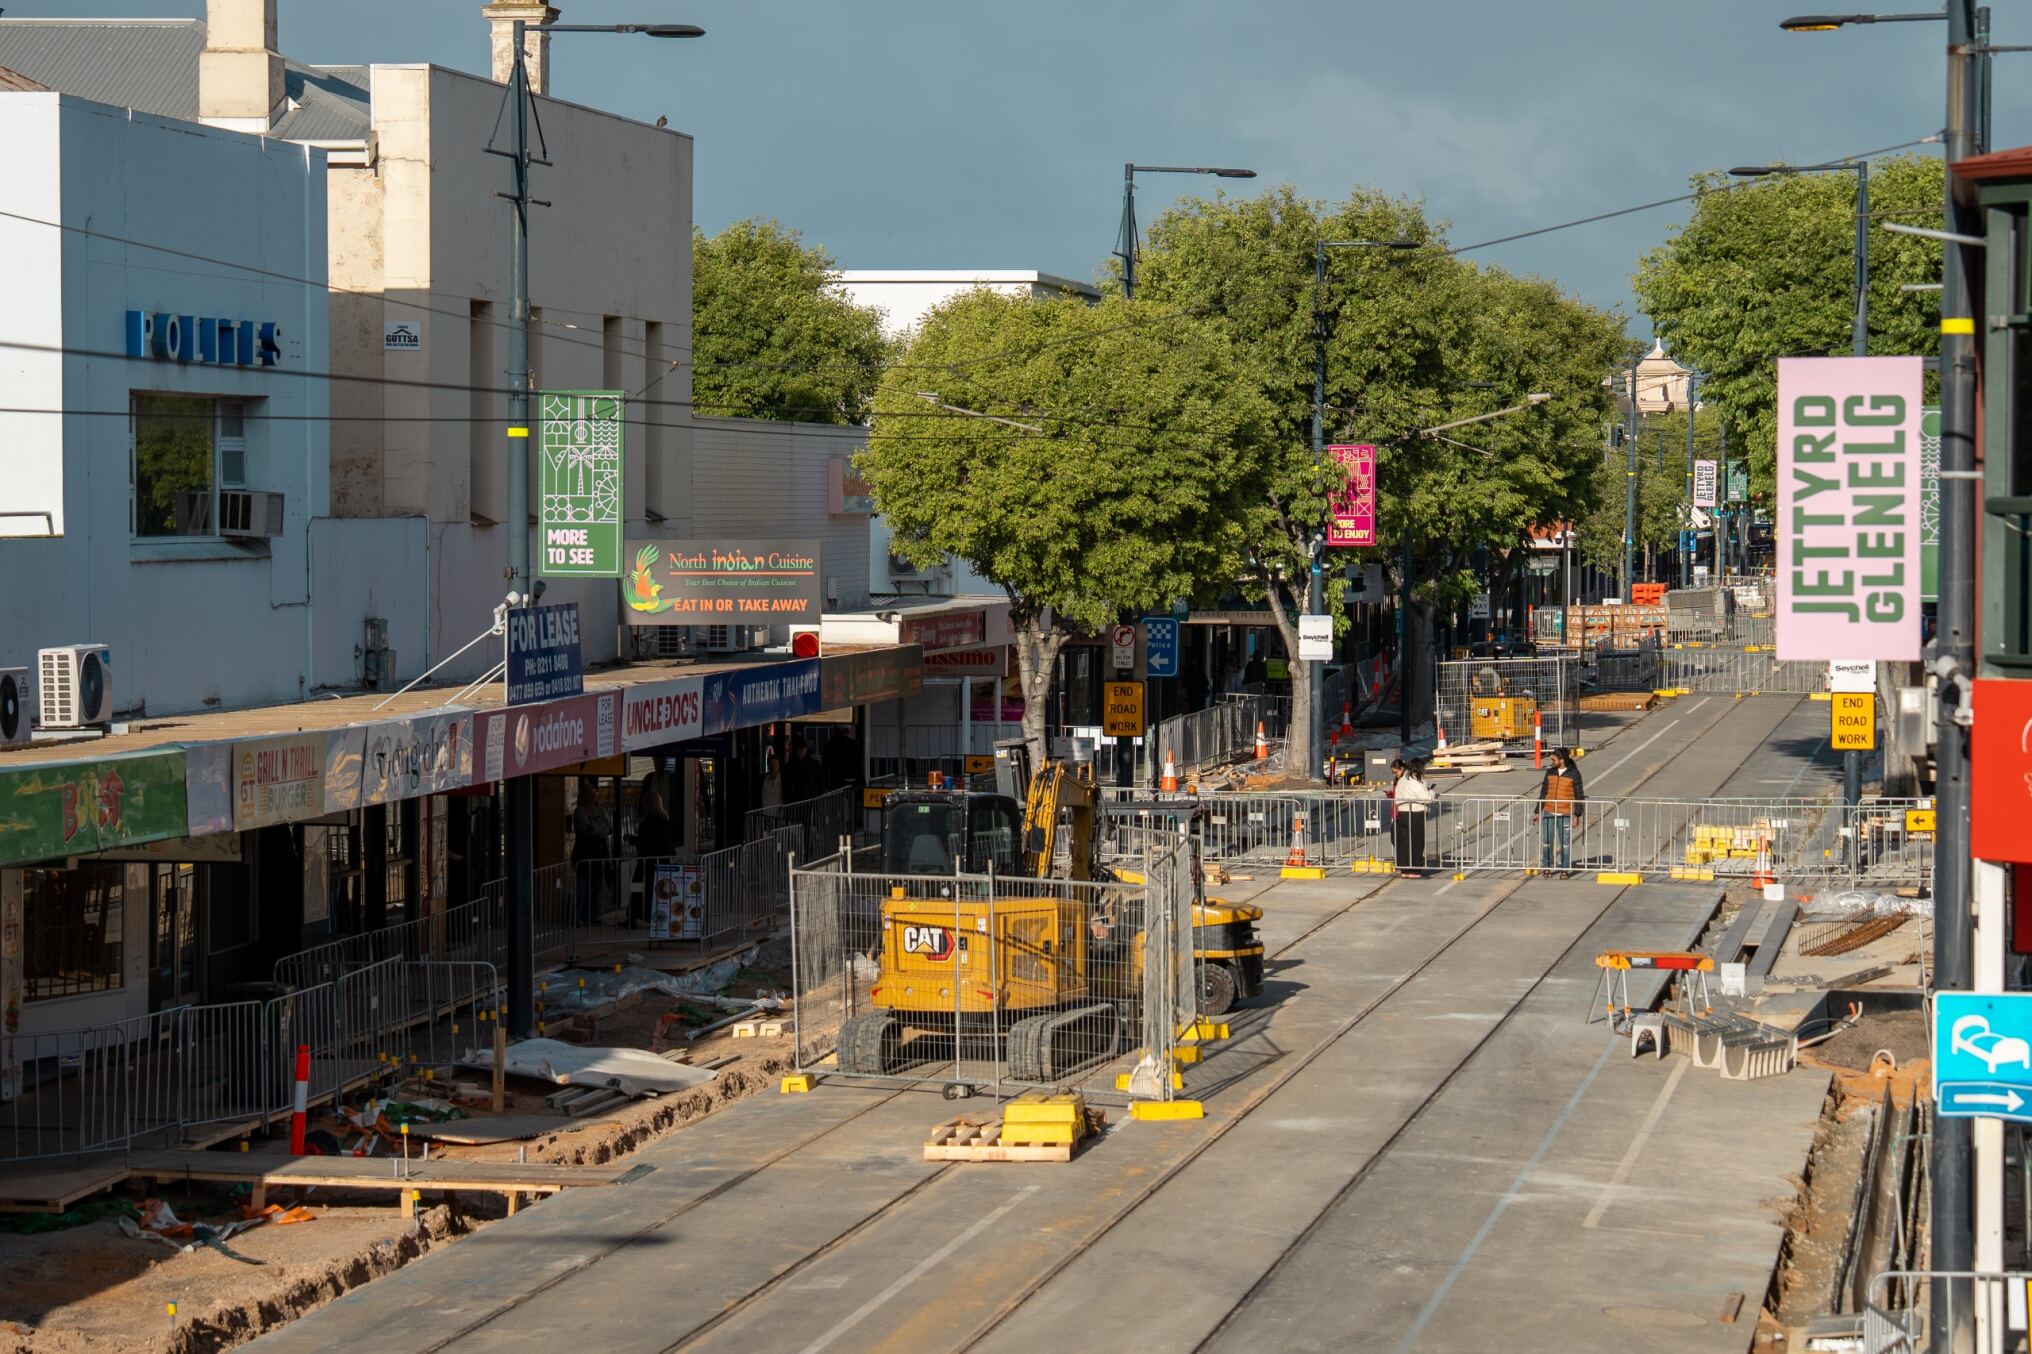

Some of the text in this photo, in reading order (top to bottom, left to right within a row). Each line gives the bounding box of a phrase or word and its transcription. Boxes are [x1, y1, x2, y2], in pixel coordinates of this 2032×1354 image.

[127, 310, 281, 367] POLITES
[386, 334, 418, 343] GUTTSA
[1844, 395, 1906, 623] GLENELG
[547, 529, 588, 546] MORE
[1344, 530, 1370, 539] ENJOY
[547, 548, 595, 565] TO SEE
[669, 549, 814, 571] North indian Cuisine
[685, 579, 700, 587] Your
[739, 578, 747, 587] of
[748, 578, 770, 586] Indian
[772, 578, 796, 586] Cuisine
[674, 599, 808, 612] EAT IN OR TAKE AWAY
[510, 610, 579, 654] FOR LEASE
[1147, 641, 1171, 649] Police
[1835, 664, 1870, 672] Seychell
[742, 679, 780, 705] AUTHENTIC
[783, 675, 799, 698] THAI
[800, 672, 818, 695] FOOD
[1114, 686, 1133, 697] END
[1110, 704, 1137, 714] ROAD
[1842, 698, 1863, 708] END
[598, 711, 614, 725] LEASE
[627, 697, 663, 736] UNCLE
[664, 691, 698, 728] DOC'S
[1109, 722, 1137, 732] WORK
[1839, 716, 1867, 726] ROAD
[487, 732, 504, 747] LEASE
[1838, 734, 1868, 744] WORK
[257, 744, 319, 785] GRILL N THRILL
[241, 779, 255, 803] GT
[268, 782, 307, 812] BURGER
[904, 926, 944, 954] CAT
